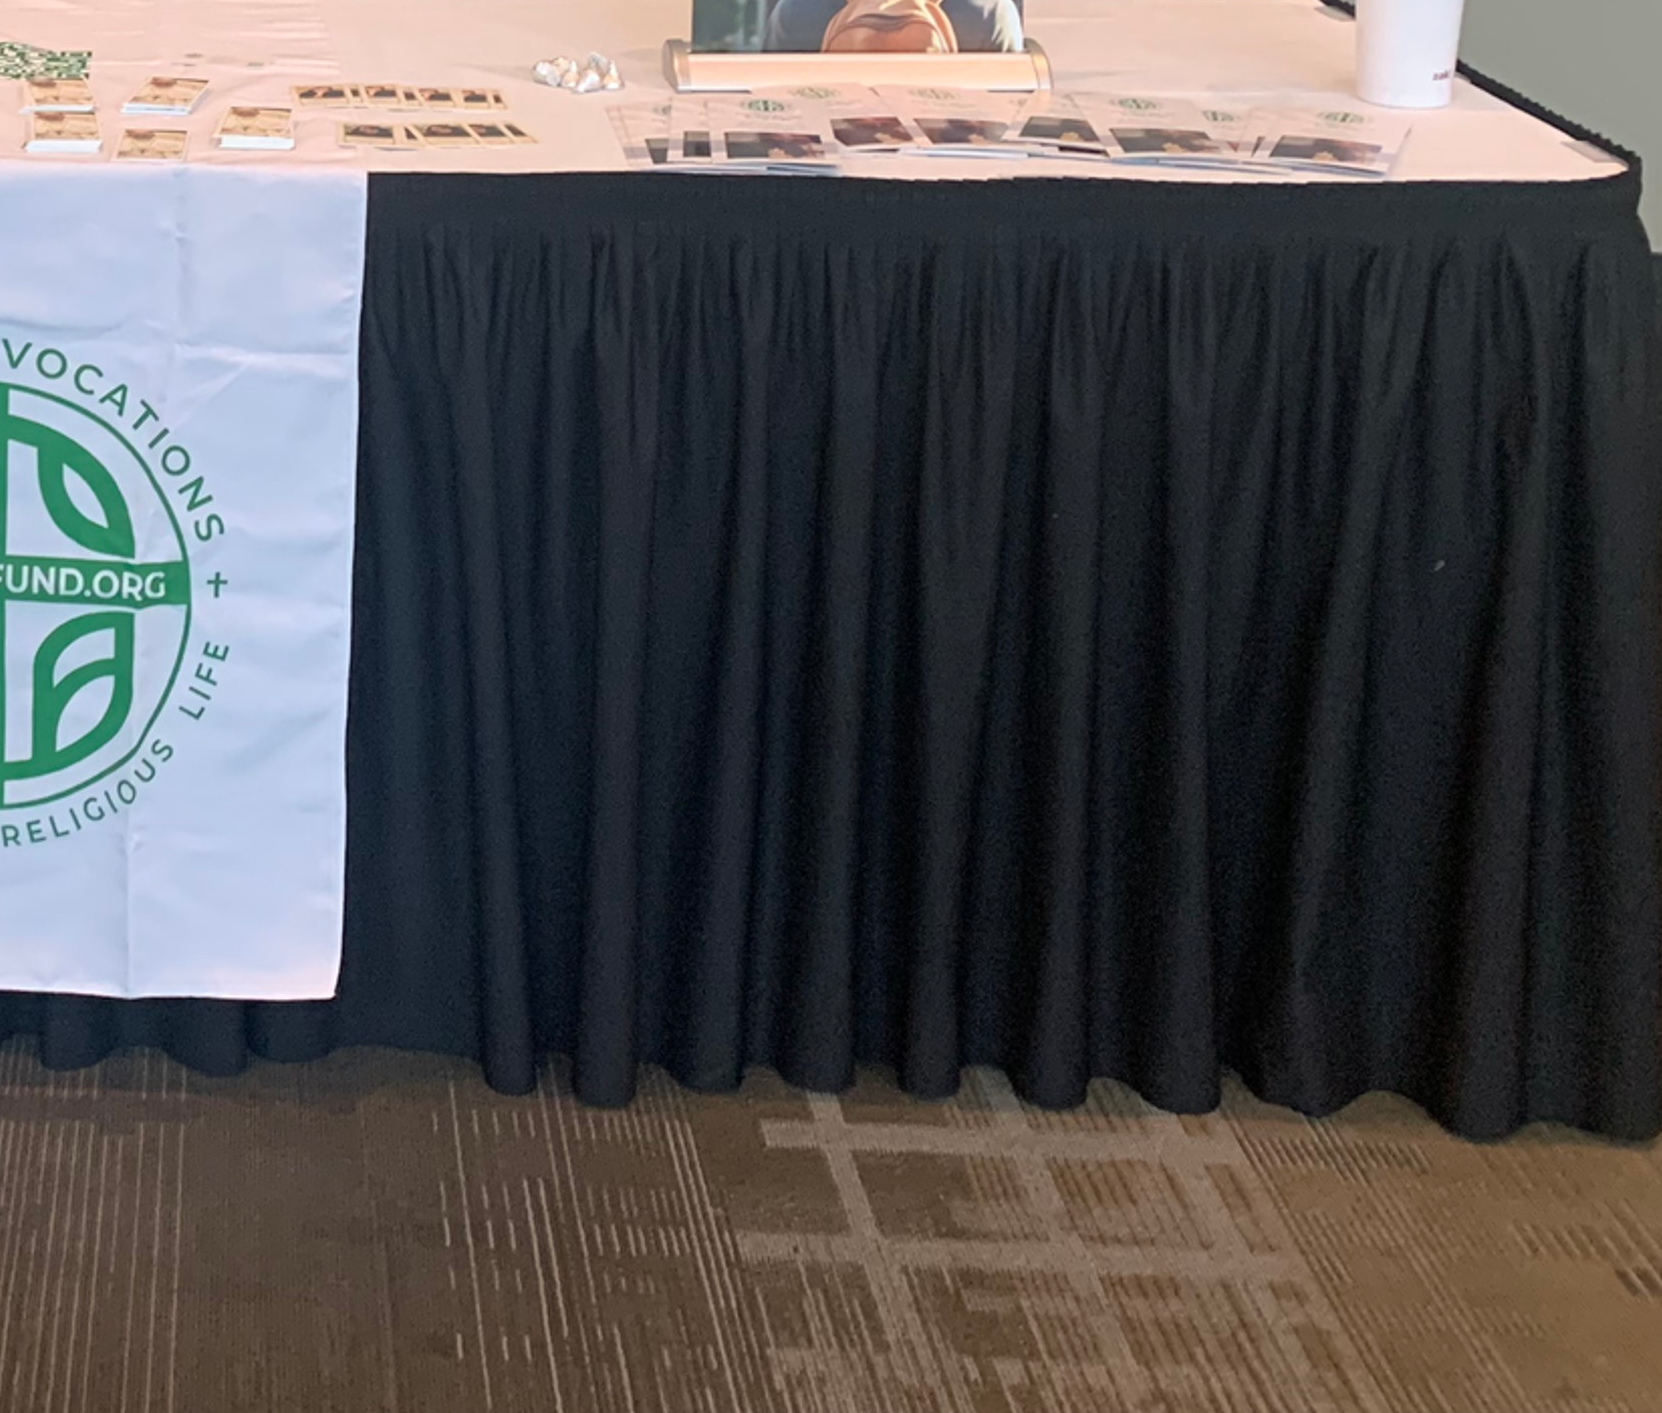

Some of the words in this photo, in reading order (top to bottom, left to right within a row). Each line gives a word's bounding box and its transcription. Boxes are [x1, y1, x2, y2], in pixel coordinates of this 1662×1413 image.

[2, 338, 224, 541] VOCATIONS
[2, 739, 174, 847] RELIGIOUS
[179, 641, 229, 720] LIFE
